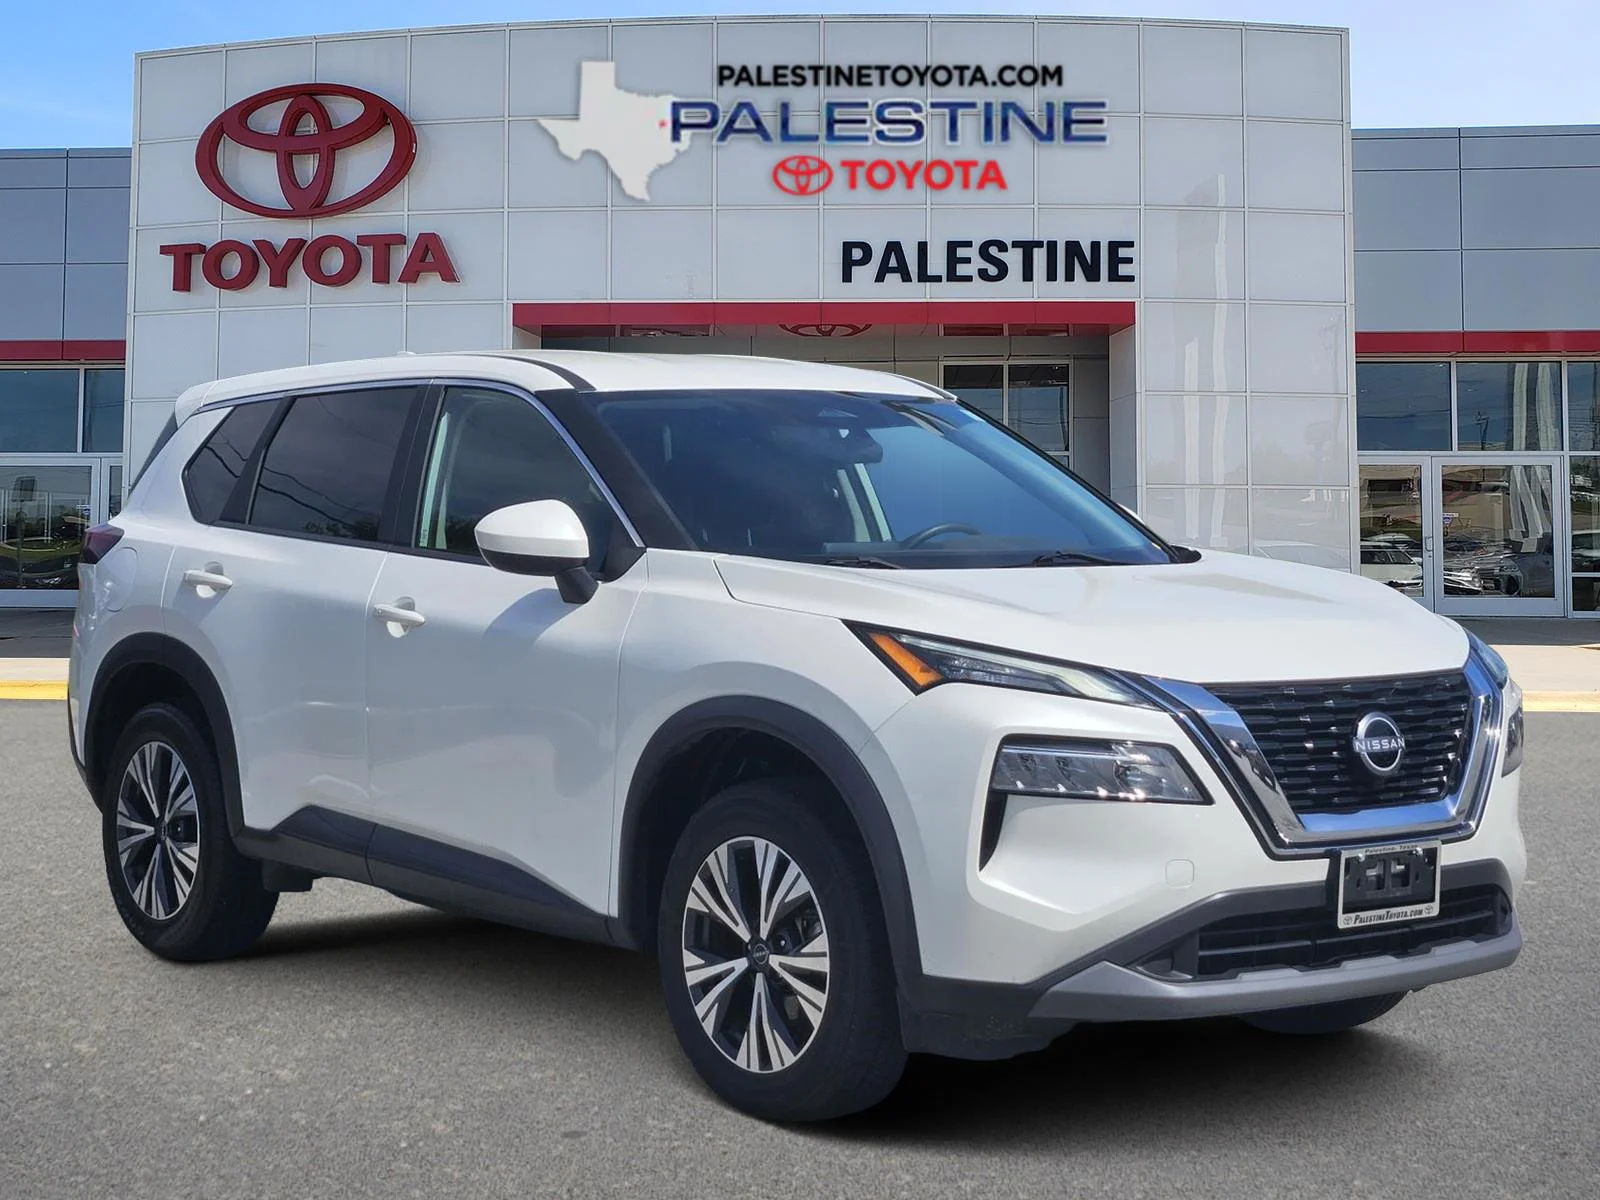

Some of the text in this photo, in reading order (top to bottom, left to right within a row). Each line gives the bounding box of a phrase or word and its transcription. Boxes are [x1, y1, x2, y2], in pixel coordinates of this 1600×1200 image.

[159, 232, 460, 292] TOYOTA
[842, 239, 1136, 284] PALESTINE
[1355, 737, 1406, 751] NISSAN
